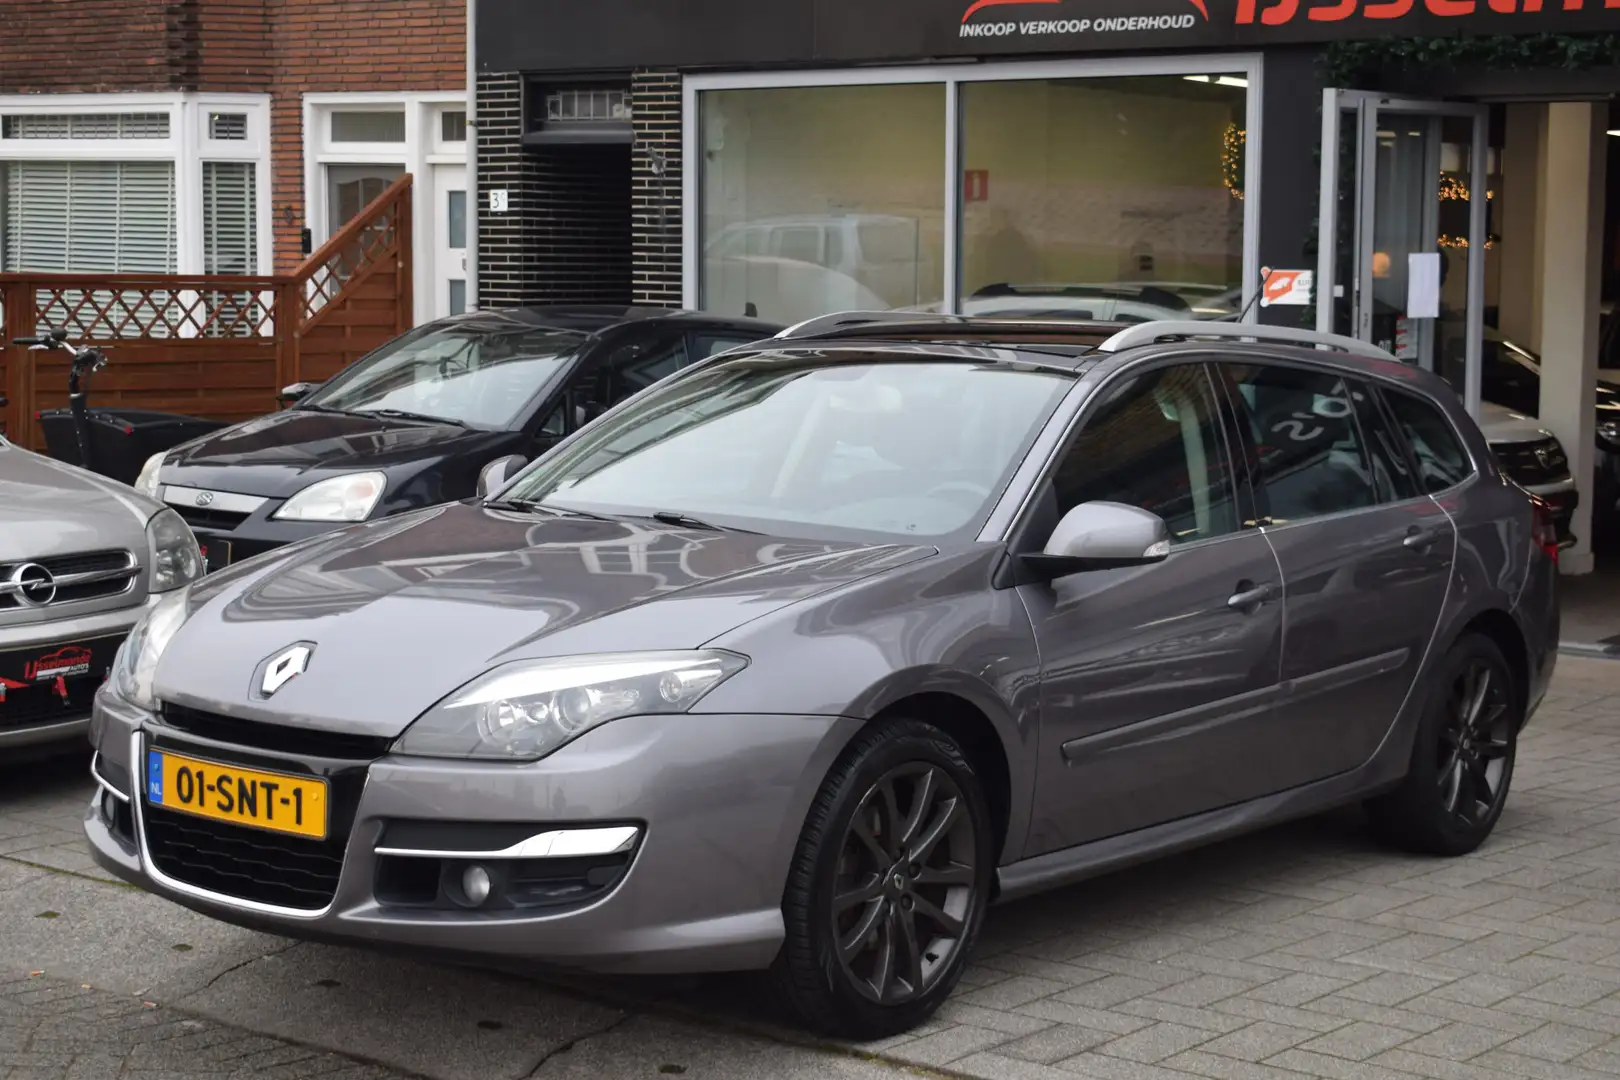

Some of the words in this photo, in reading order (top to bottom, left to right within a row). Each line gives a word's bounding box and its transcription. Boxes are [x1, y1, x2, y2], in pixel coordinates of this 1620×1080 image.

[959, 22, 1016, 38] INKOOP
[1019, 19, 1091, 35] VERKOOP
[1093, 14, 1196, 32] ONDERHOUD
[151, 781, 162, 795] NL
[176, 765, 303, 826] 01-SNT-1
